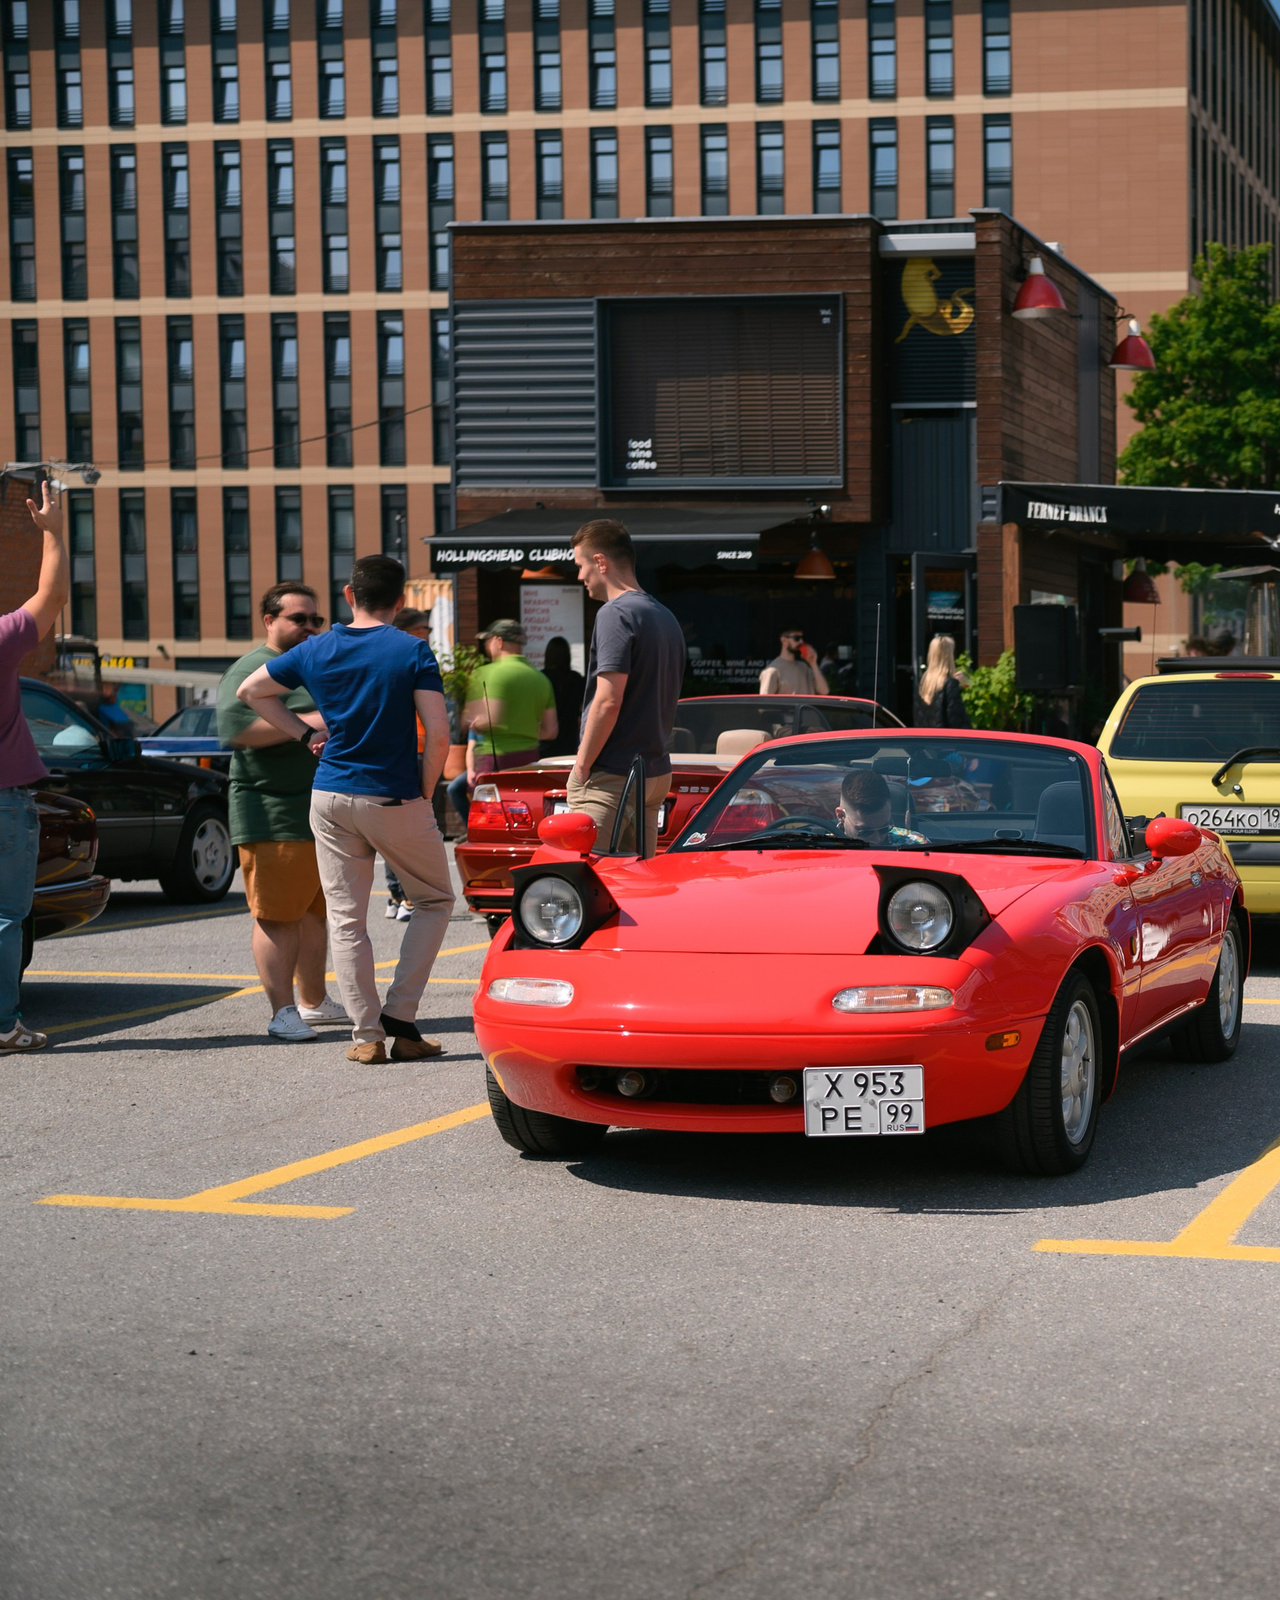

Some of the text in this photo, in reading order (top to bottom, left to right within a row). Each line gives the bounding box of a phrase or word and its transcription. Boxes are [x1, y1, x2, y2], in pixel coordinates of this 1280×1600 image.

[626, 438, 652, 449] food
[627, 448, 653, 458] wine
[625, 459, 657, 470] coffee
[1027, 501, 1108, 523] FERNET-BRANCA
[436, 549, 574, 562] HOLLINGSHEAD CLUBHO
[716, 550, 737, 560] SINCE
[853, 1071, 905, 1097] 953
[886, 1103, 912, 1123] 99
